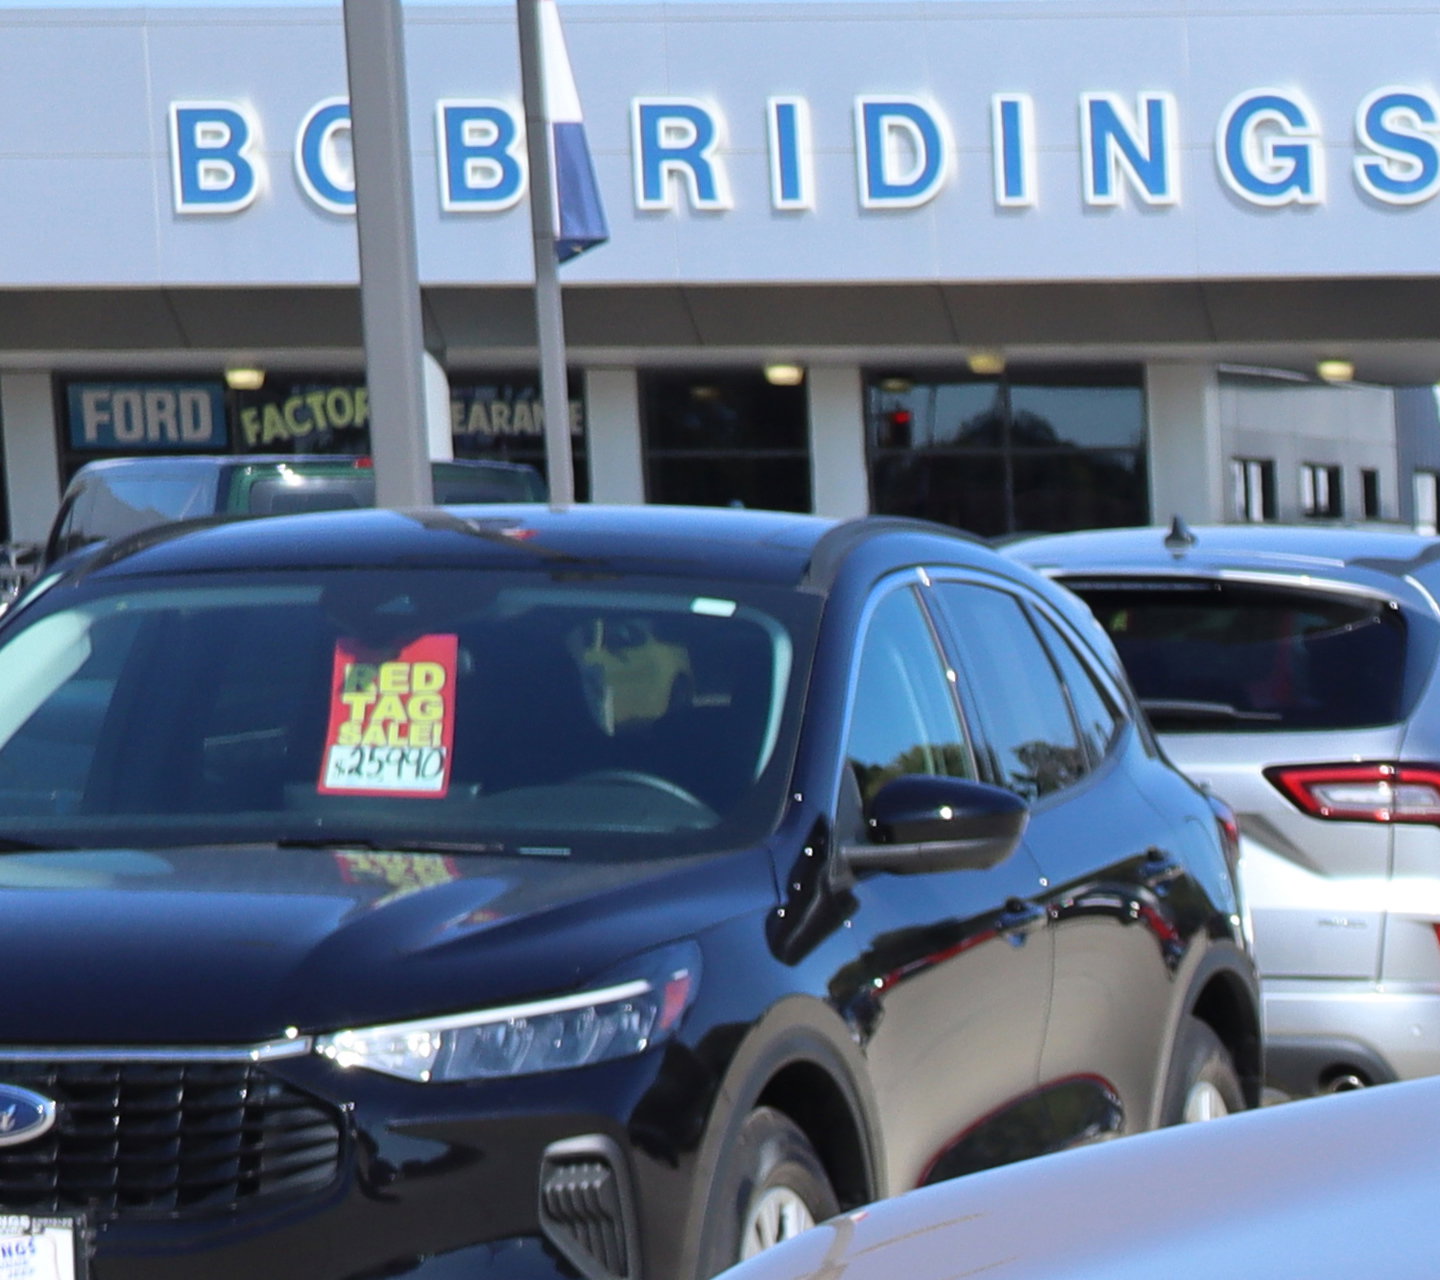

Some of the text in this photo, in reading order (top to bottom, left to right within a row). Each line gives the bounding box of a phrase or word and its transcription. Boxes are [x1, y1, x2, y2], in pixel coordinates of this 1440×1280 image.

[83, 387, 213, 443] FORD
[241, 386, 369, 449] FACTOR
[345, 661, 446, 694] RED
[342, 693, 445, 723] TAG
[338, 721, 443, 748] SALE!
